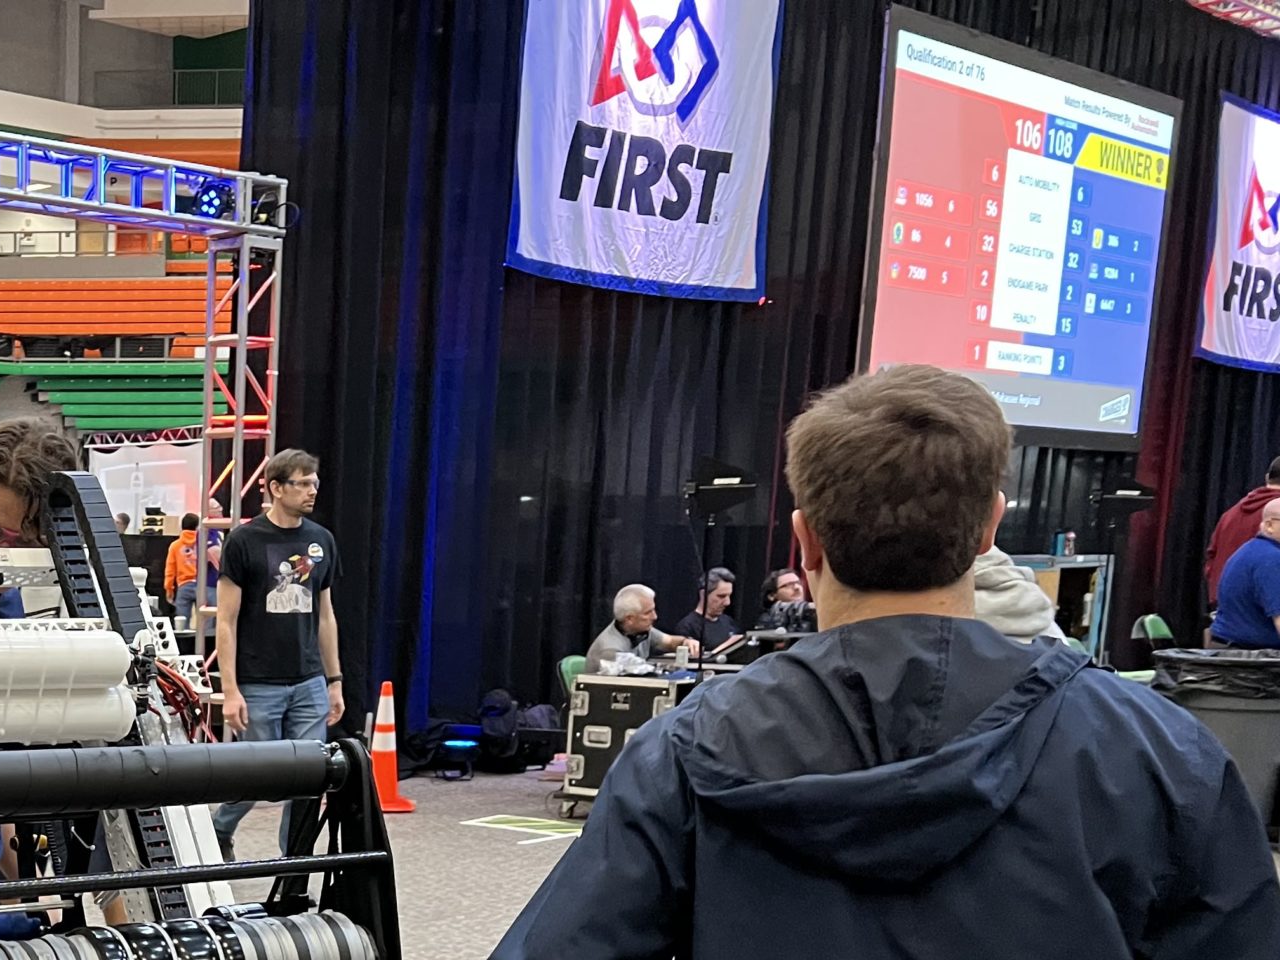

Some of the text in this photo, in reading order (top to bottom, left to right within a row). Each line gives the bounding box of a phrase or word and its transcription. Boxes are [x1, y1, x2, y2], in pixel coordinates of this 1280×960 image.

[906, 43, 986, 81] Qualification 2 of 76
[1015, 118, 1042, 150] 106
[1048, 128, 1074, 159] 108
[1099, 141, 1153, 181] WINNER
[559, 120, 733, 225] FIRST
[991, 165, 999, 182] 6
[1077, 186, 1084, 202] 6
[986, 199, 998, 217] 56
[1071, 219, 1083, 235] 53
[982, 234, 994, 252] 32
[1067, 252, 1079, 268] 32
[981, 269, 989, 287] 2
[1066, 285, 1073, 300] 2
[975, 304, 987, 321] 10
[1061, 318, 1072, 334] 15
[974, 345, 980, 360] 1
[1058, 355, 1065, 371] 3
